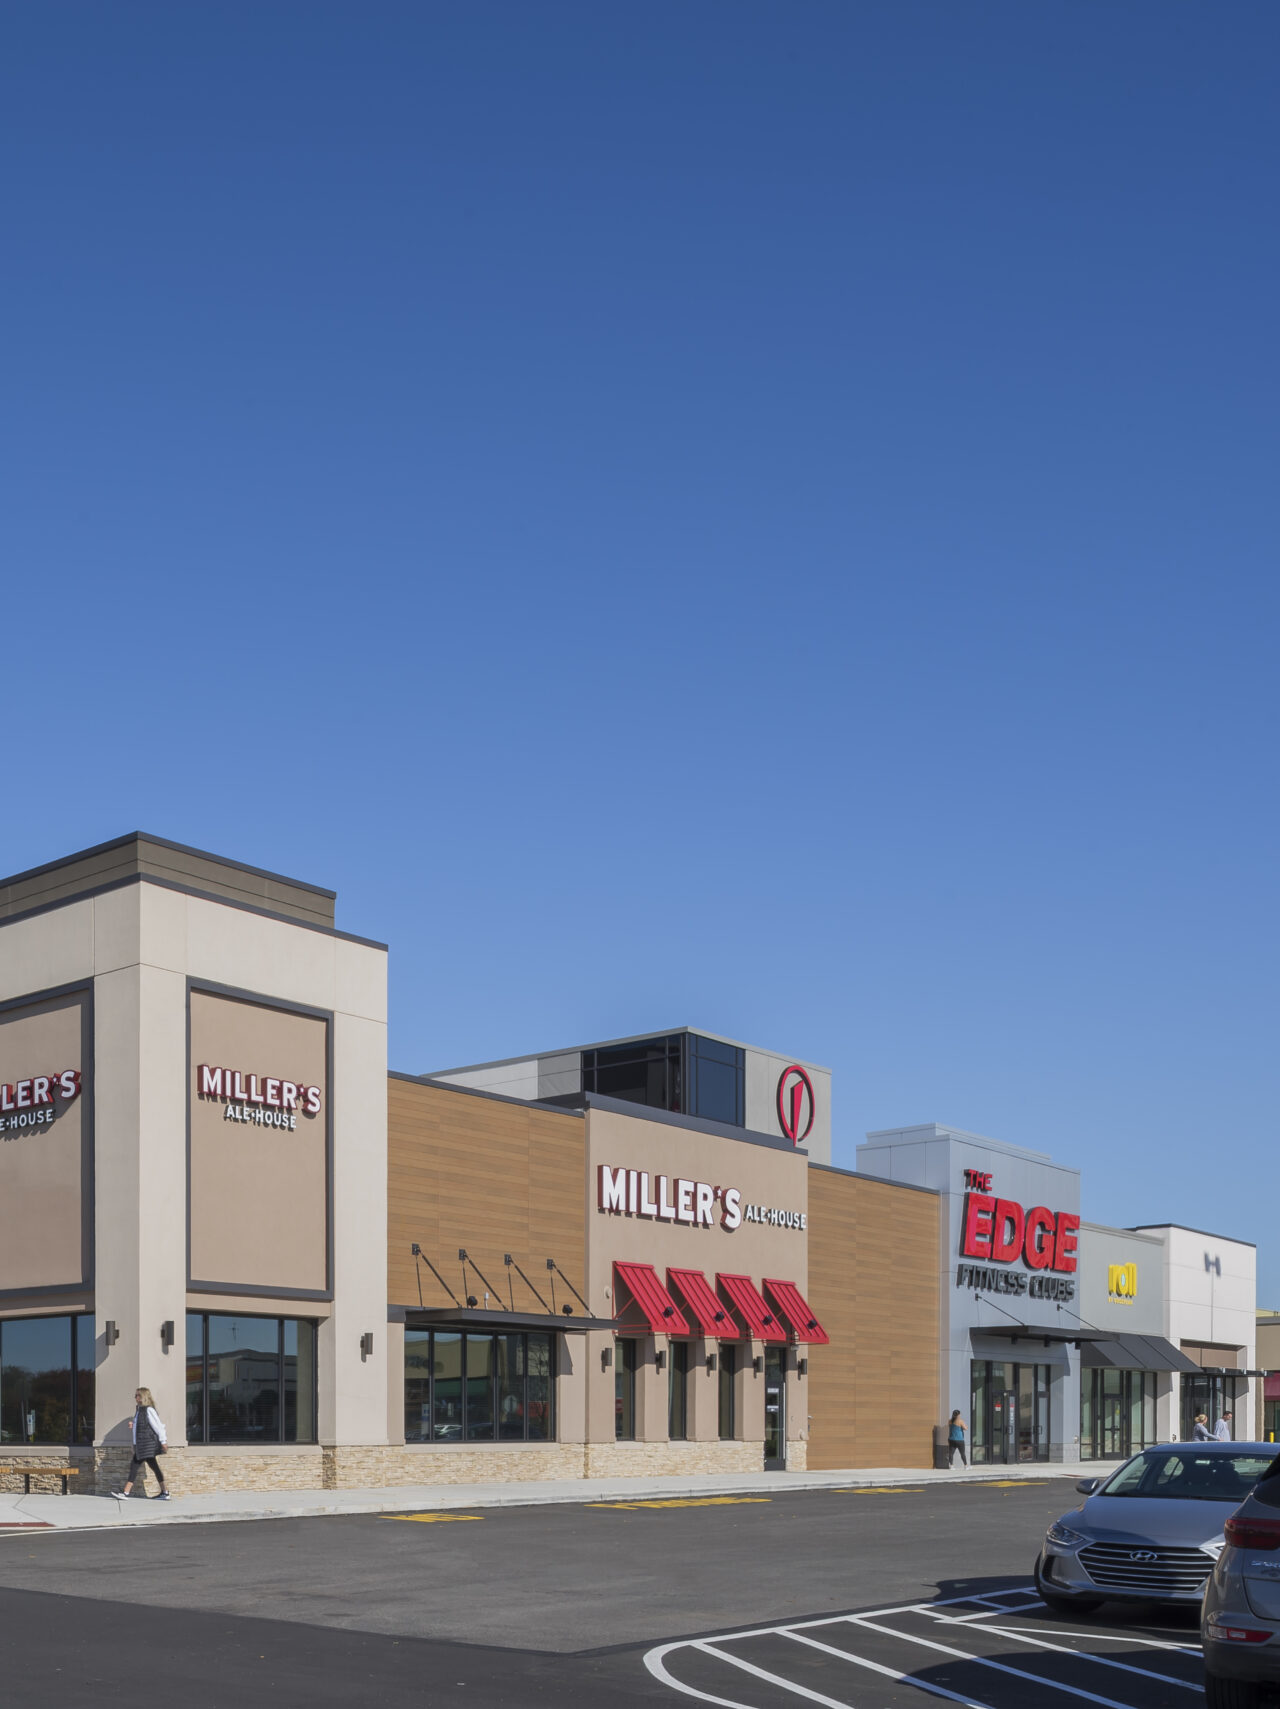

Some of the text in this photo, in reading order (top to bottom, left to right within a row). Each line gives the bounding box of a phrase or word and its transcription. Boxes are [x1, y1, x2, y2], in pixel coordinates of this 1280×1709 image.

[198, 1064, 322, 1114] MILLER'S
[598, 1165, 743, 1230] MILLER'S
[965, 1169, 993, 1192] THE
[960, 1192, 1080, 1274] EDGE
[959, 1264, 1075, 1303] FITNESS CLUBS
